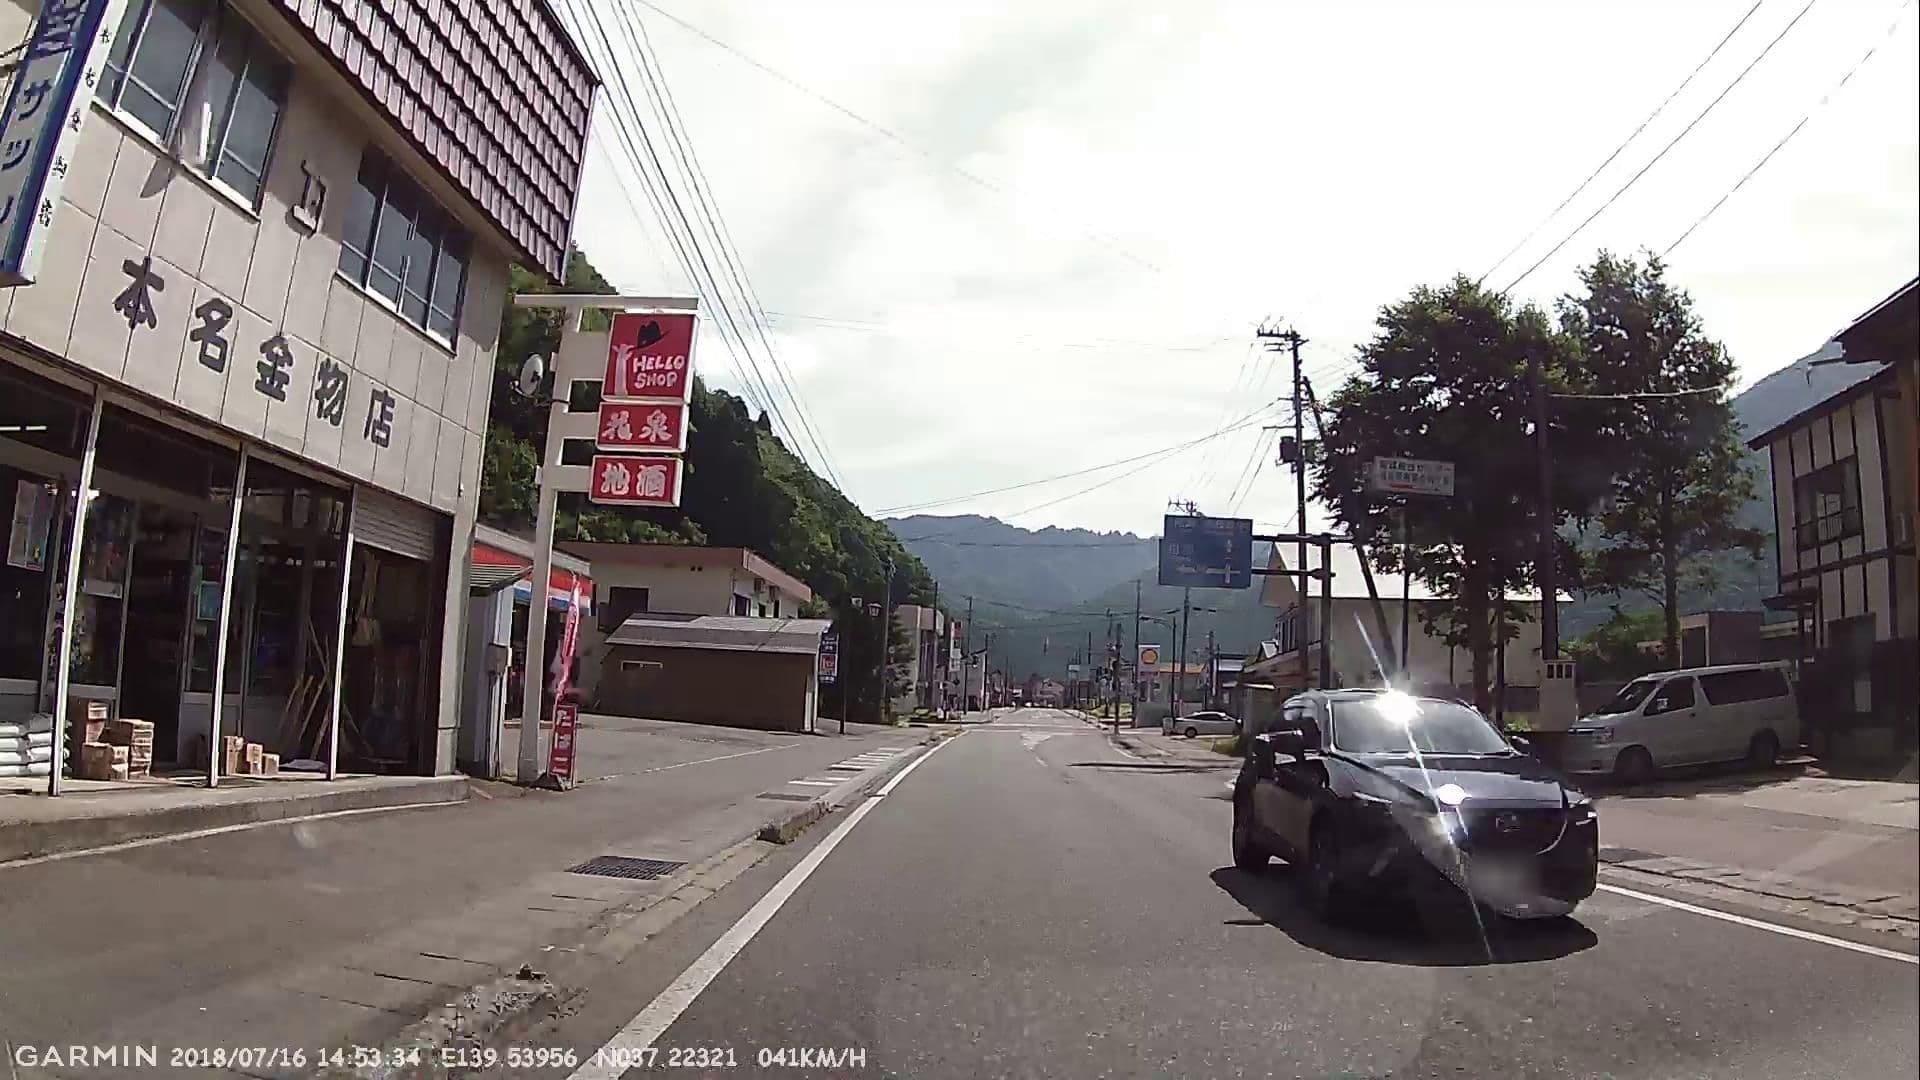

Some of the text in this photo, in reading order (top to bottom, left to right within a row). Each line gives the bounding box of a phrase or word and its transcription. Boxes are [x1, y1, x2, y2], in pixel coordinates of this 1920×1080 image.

[112, 255, 395, 449] 本名金物店
[632, 354, 686, 374] HELLO
[634, 371, 678, 390] SHOP
[600, 462, 667, 497] 地酒
